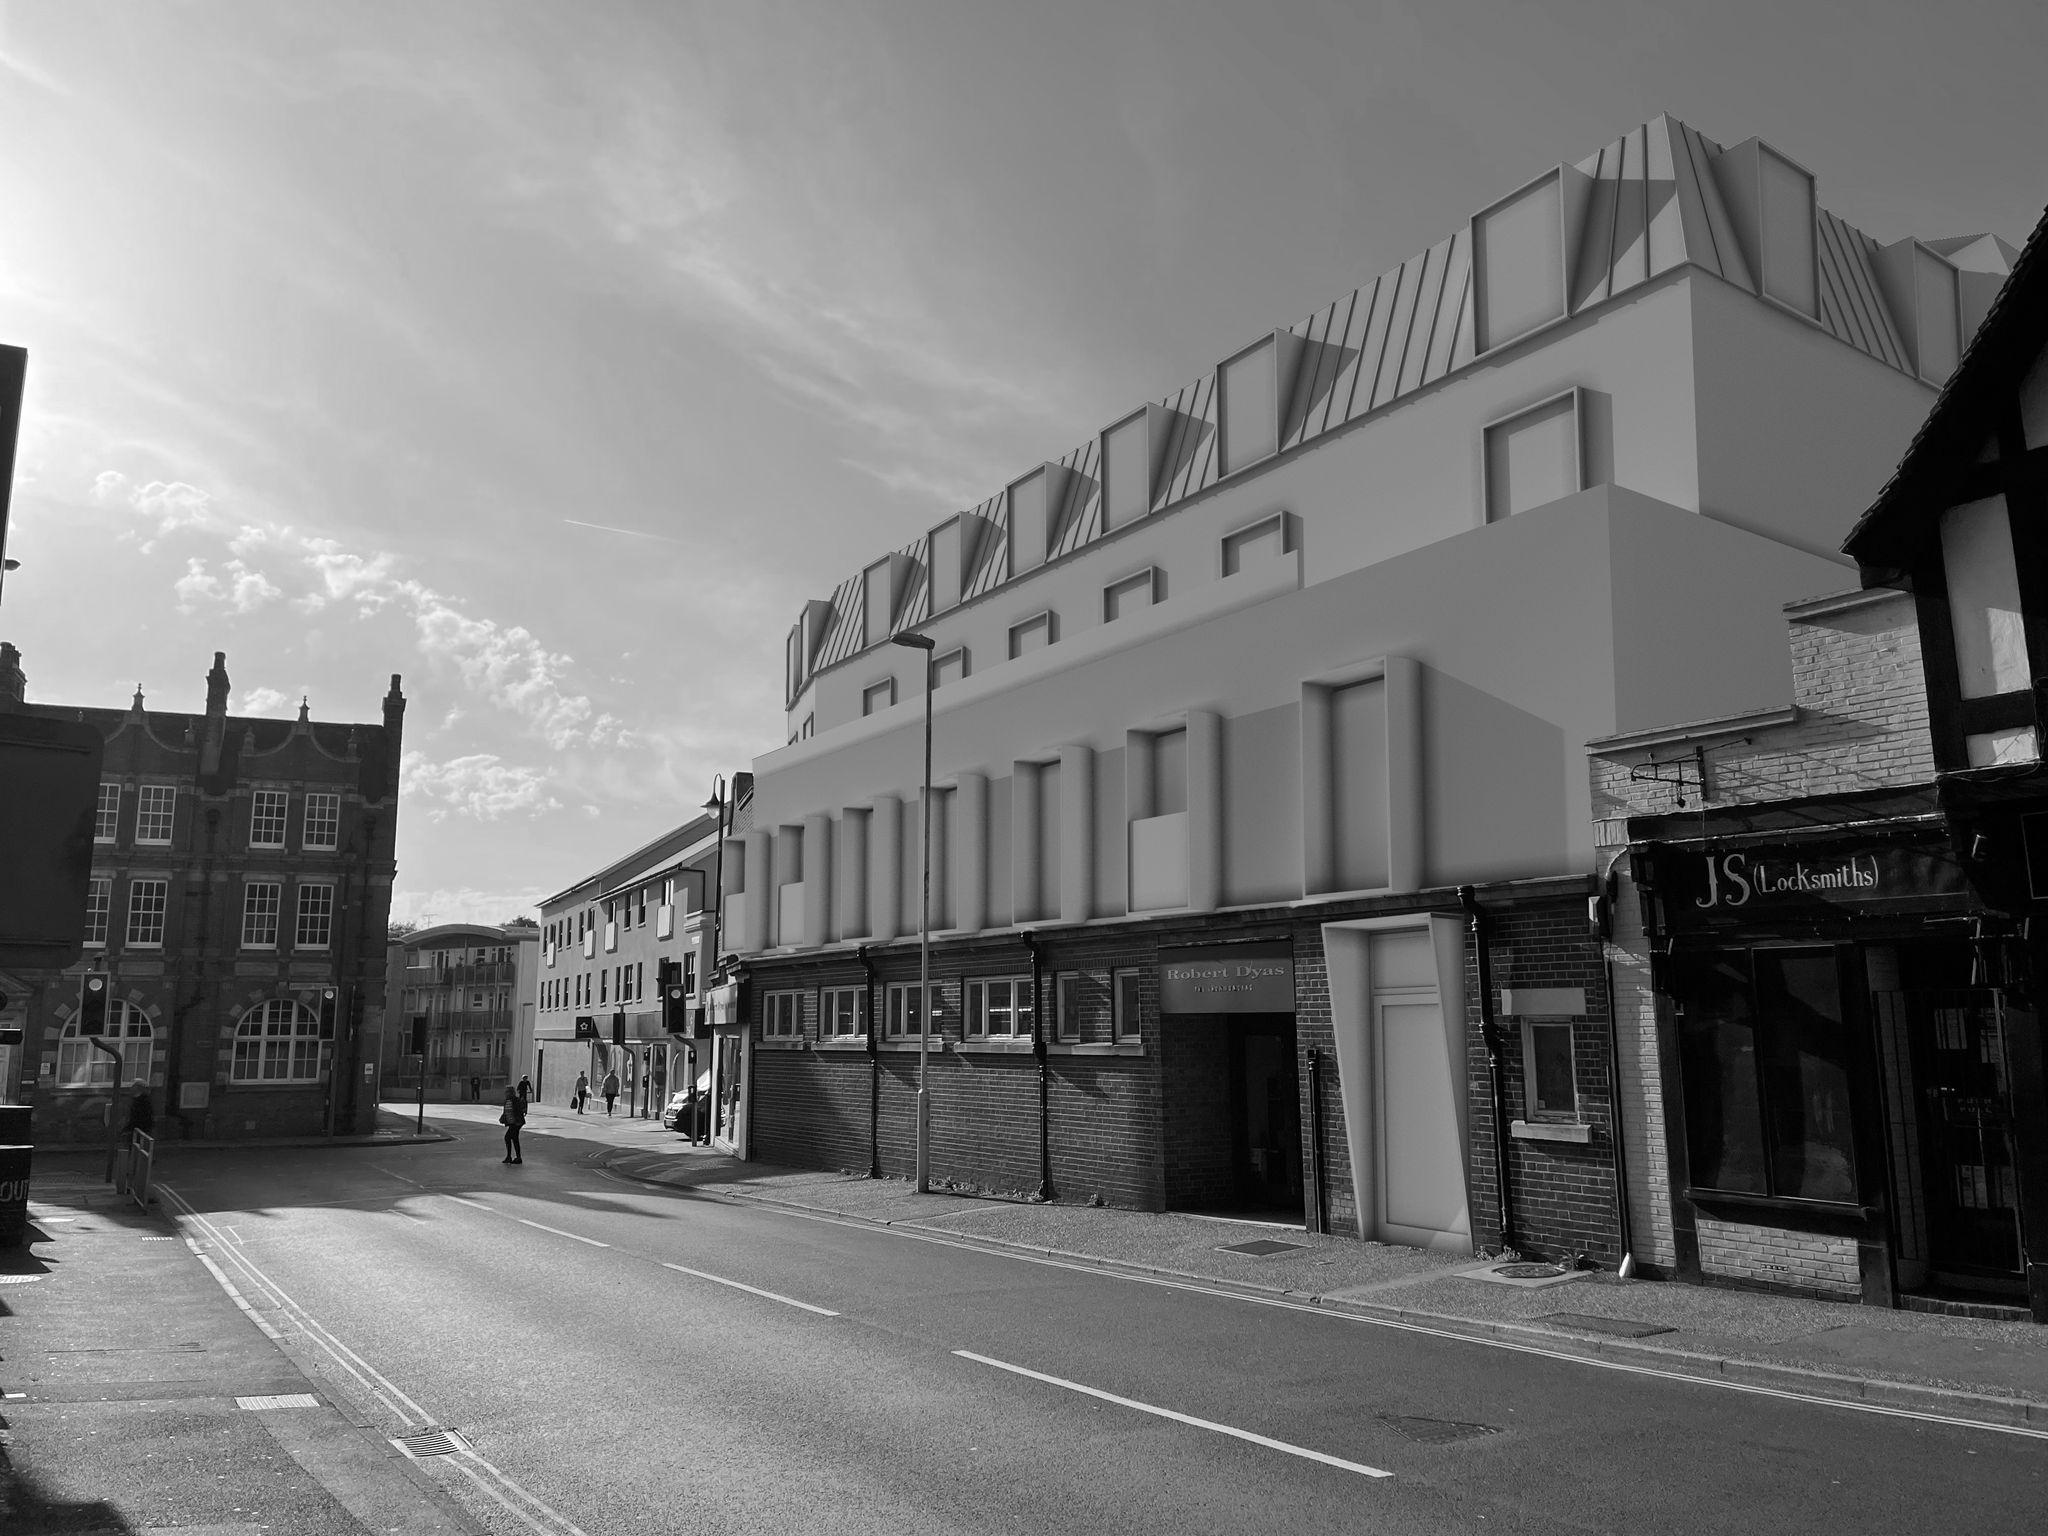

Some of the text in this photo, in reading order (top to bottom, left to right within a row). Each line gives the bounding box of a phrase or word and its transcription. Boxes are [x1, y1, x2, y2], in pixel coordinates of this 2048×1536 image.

[1696, 854, 1878, 908] JS (Locksmiths)
[1167, 965, 1285, 980] Robert Dyas
